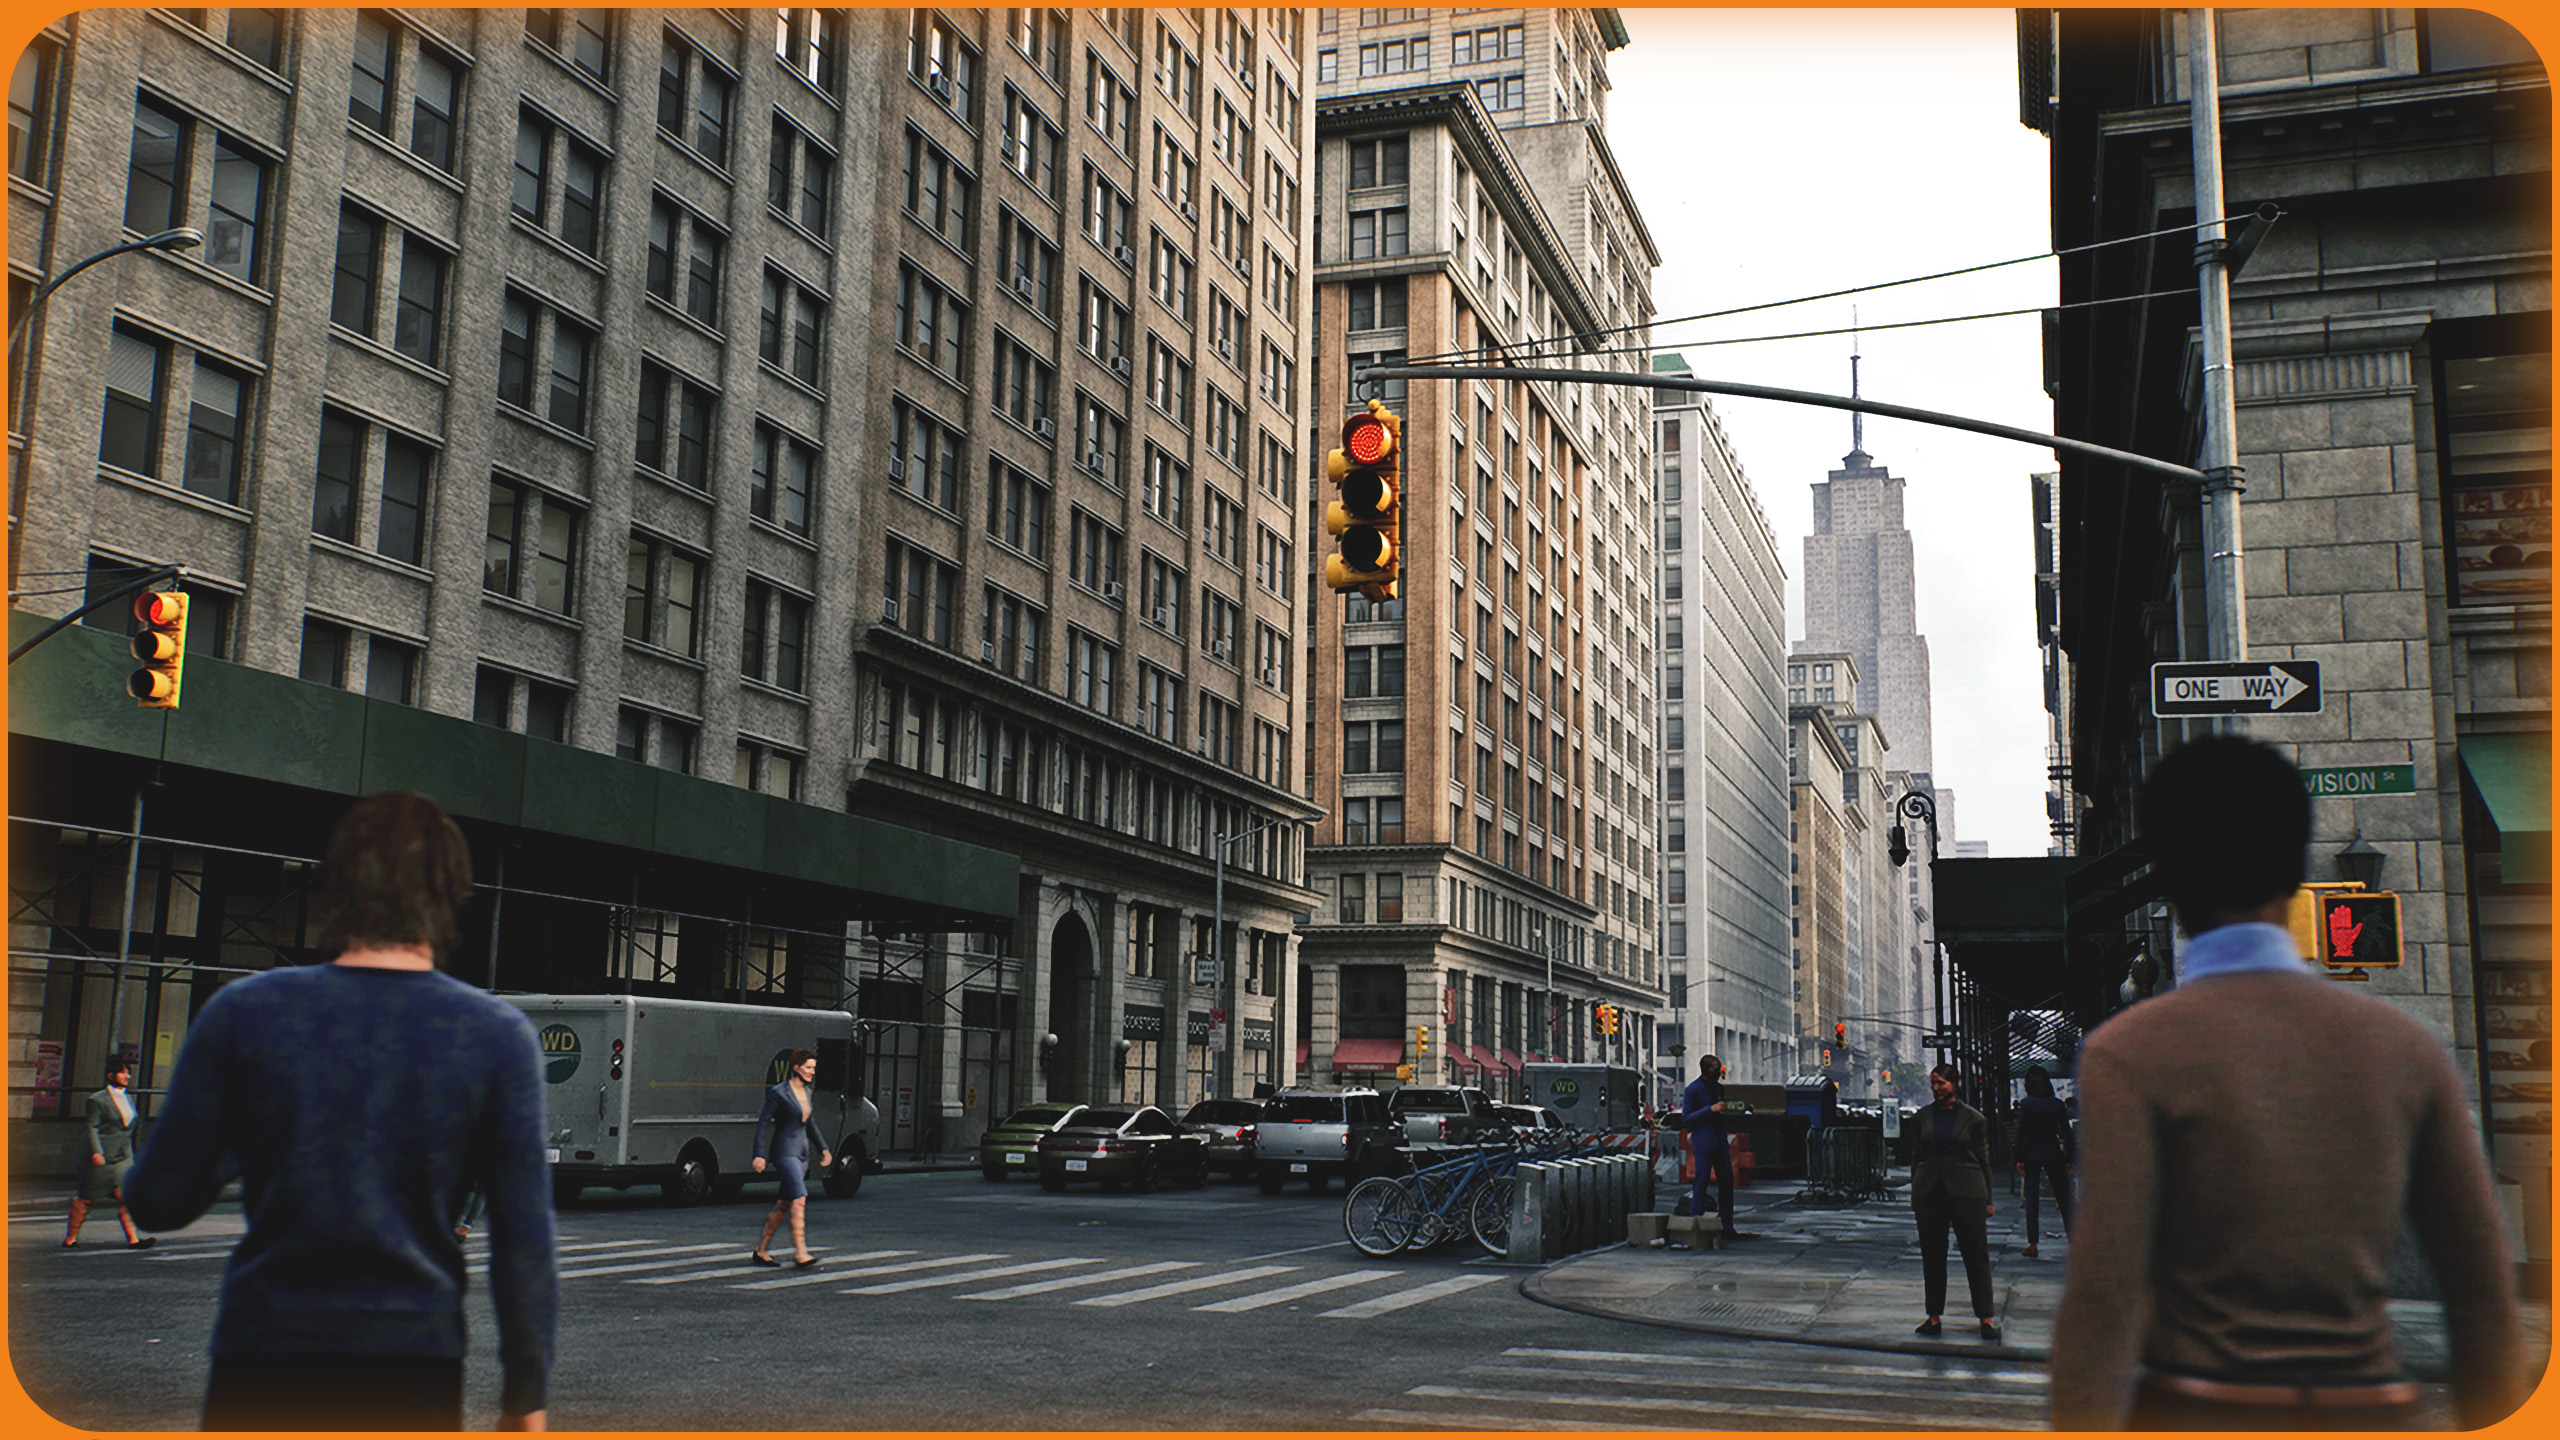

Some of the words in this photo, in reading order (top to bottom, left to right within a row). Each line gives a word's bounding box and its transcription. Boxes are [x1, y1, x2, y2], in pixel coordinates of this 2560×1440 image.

[2175, 679, 2219, 699] ONE
[2243, 677, 2290, 698] WAY
[2303, 771, 2376, 794] VISION
[1123, 1014, 1161, 1031] OOKSTORE
[541, 1032, 575, 1051] WD
[774, 1059, 793, 1083] W
[1555, 1081, 1577, 1093] WD
[1726, 1100, 1745, 1111] WD
